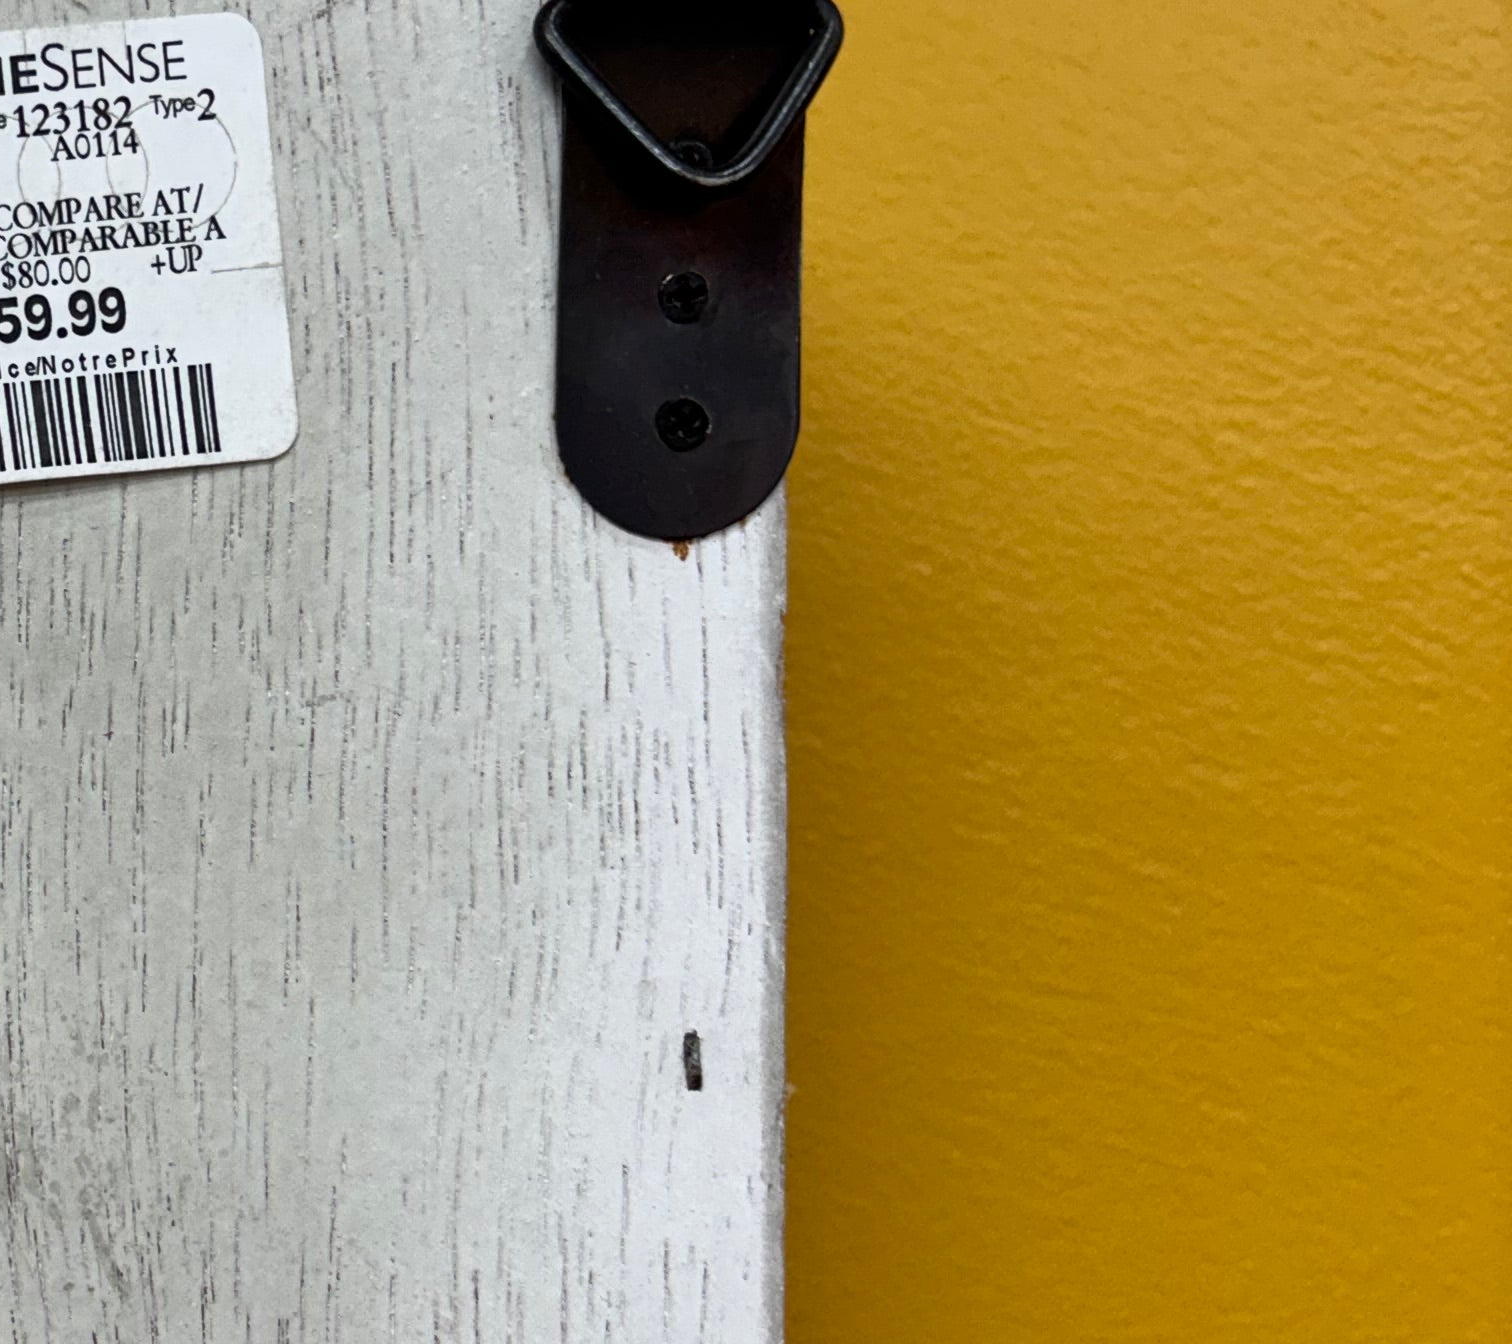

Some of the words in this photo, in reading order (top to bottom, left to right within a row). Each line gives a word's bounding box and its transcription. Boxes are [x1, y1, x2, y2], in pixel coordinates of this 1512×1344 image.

[15, 96, 133, 138] 123182
[149, 95, 195, 119] Type
[197, 88, 216, 122] 2
[51, 130, 139, 162] A0114
[151, 183, 206, 216] AT/
[202, 216, 227, 240] A
[1, 256, 91, 290] $80.00
[150, 244, 203, 275] +UP
